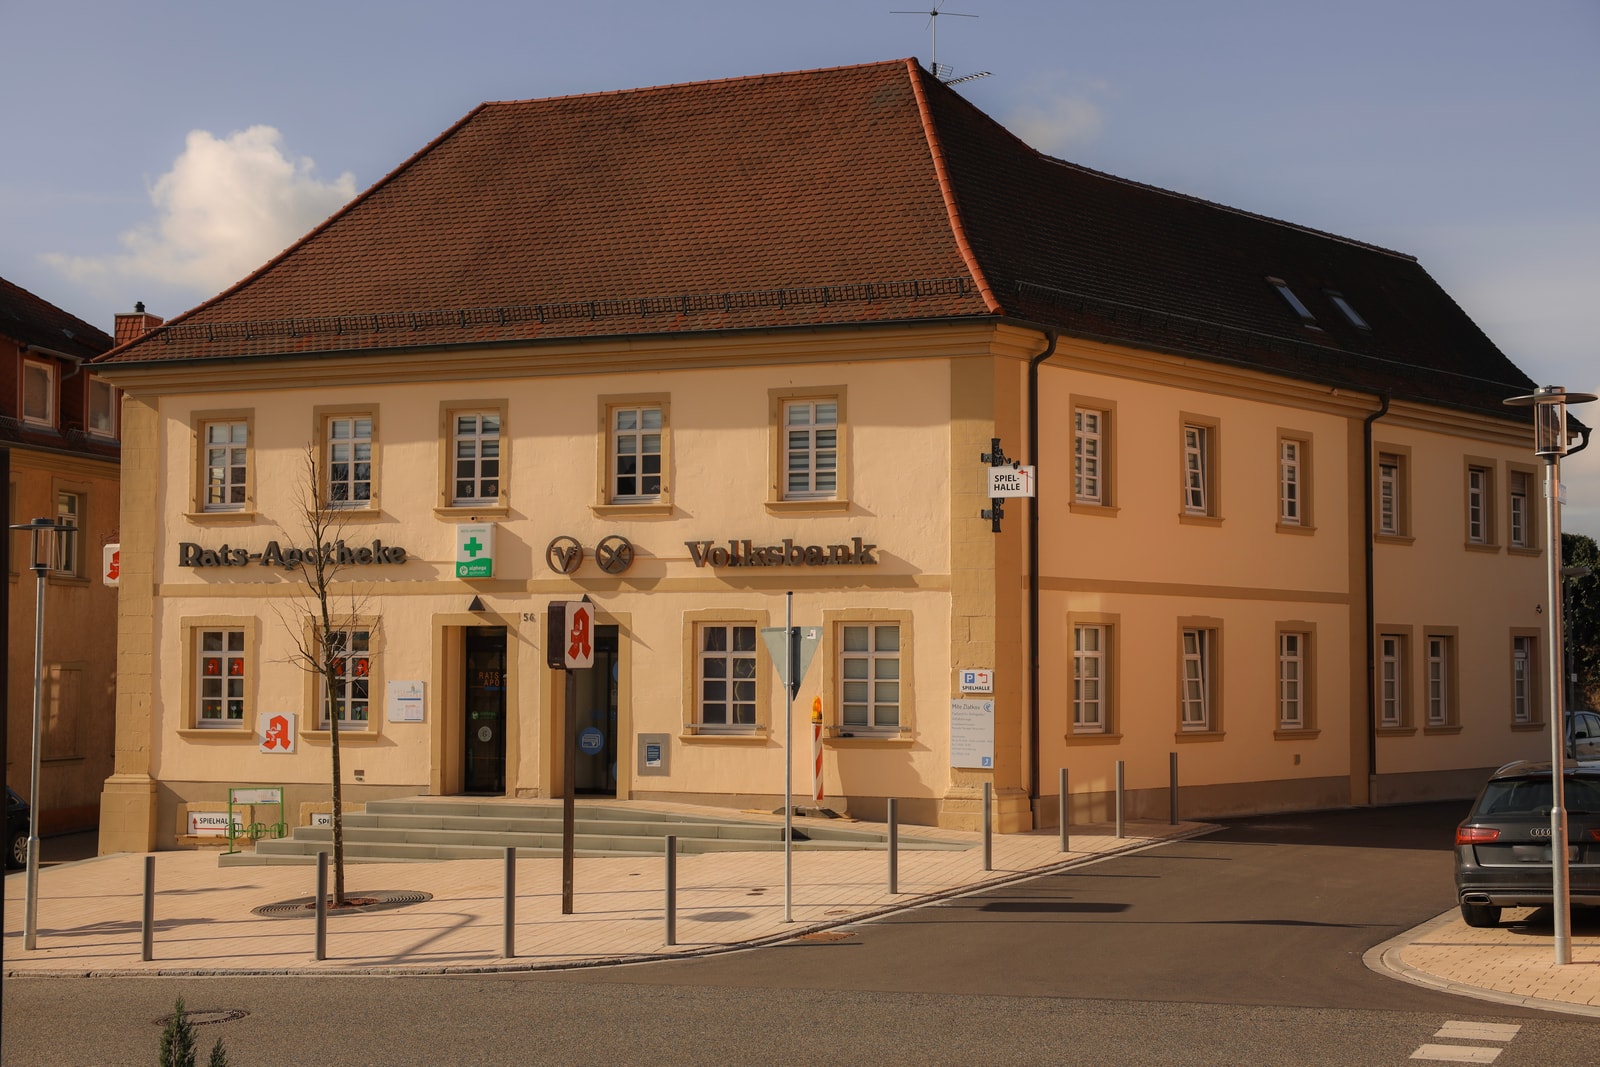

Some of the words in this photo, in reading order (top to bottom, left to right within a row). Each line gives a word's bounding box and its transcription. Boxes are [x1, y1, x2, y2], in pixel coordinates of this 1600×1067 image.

[994, 474, 1020, 482] SPIEL-
[993, 483, 1021, 491] HALLE
[178, 539, 407, 571] Rats-Apotheke
[684, 537, 878, 568] Volksbank
[523, 612, 536, 623] 56
[199, 817, 236, 825] SPIELHALE
